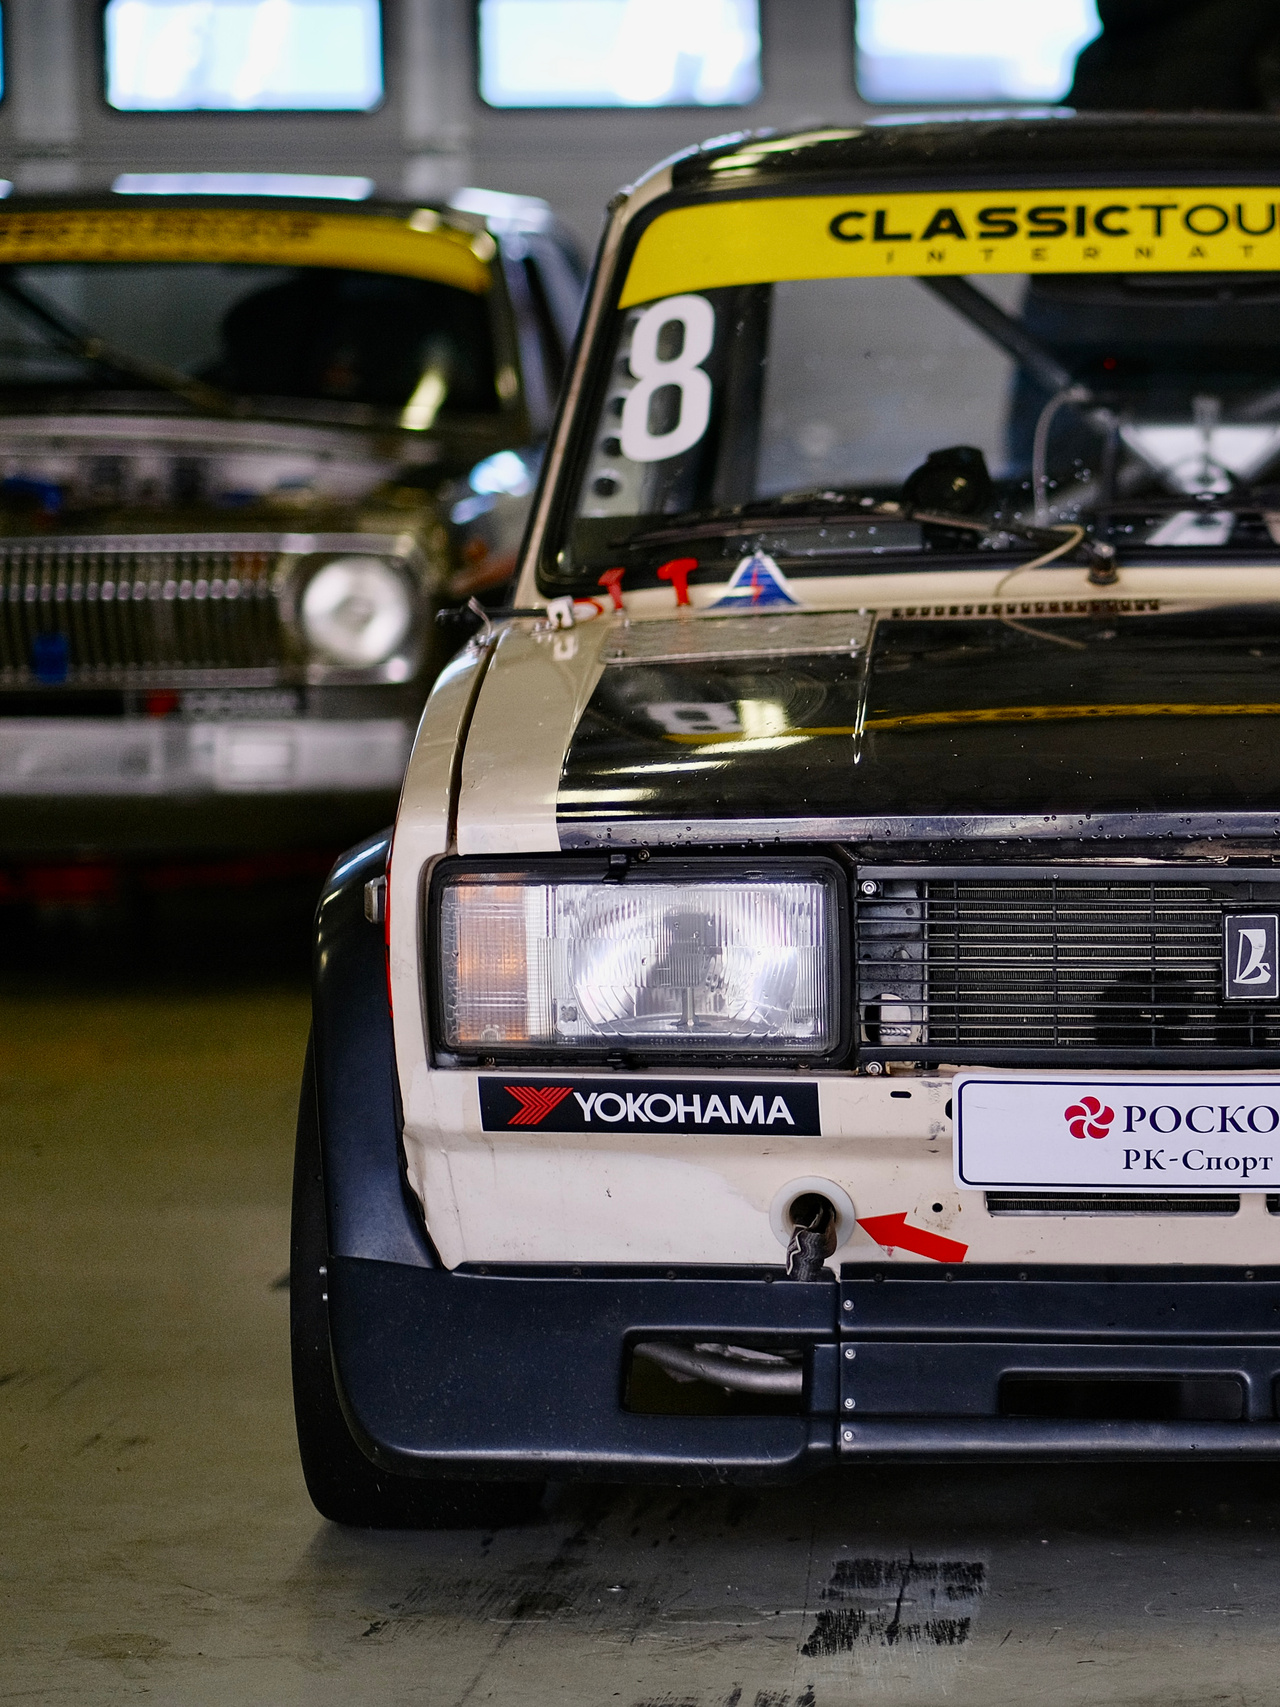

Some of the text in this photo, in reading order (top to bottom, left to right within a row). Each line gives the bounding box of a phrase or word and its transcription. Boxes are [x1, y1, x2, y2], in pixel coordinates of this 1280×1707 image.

[619, 293, 715, 463] 8
[573, 1092, 796, 1125] YOKOHAMA
[1122, 1148, 1273, 1178] РК-Спорт
